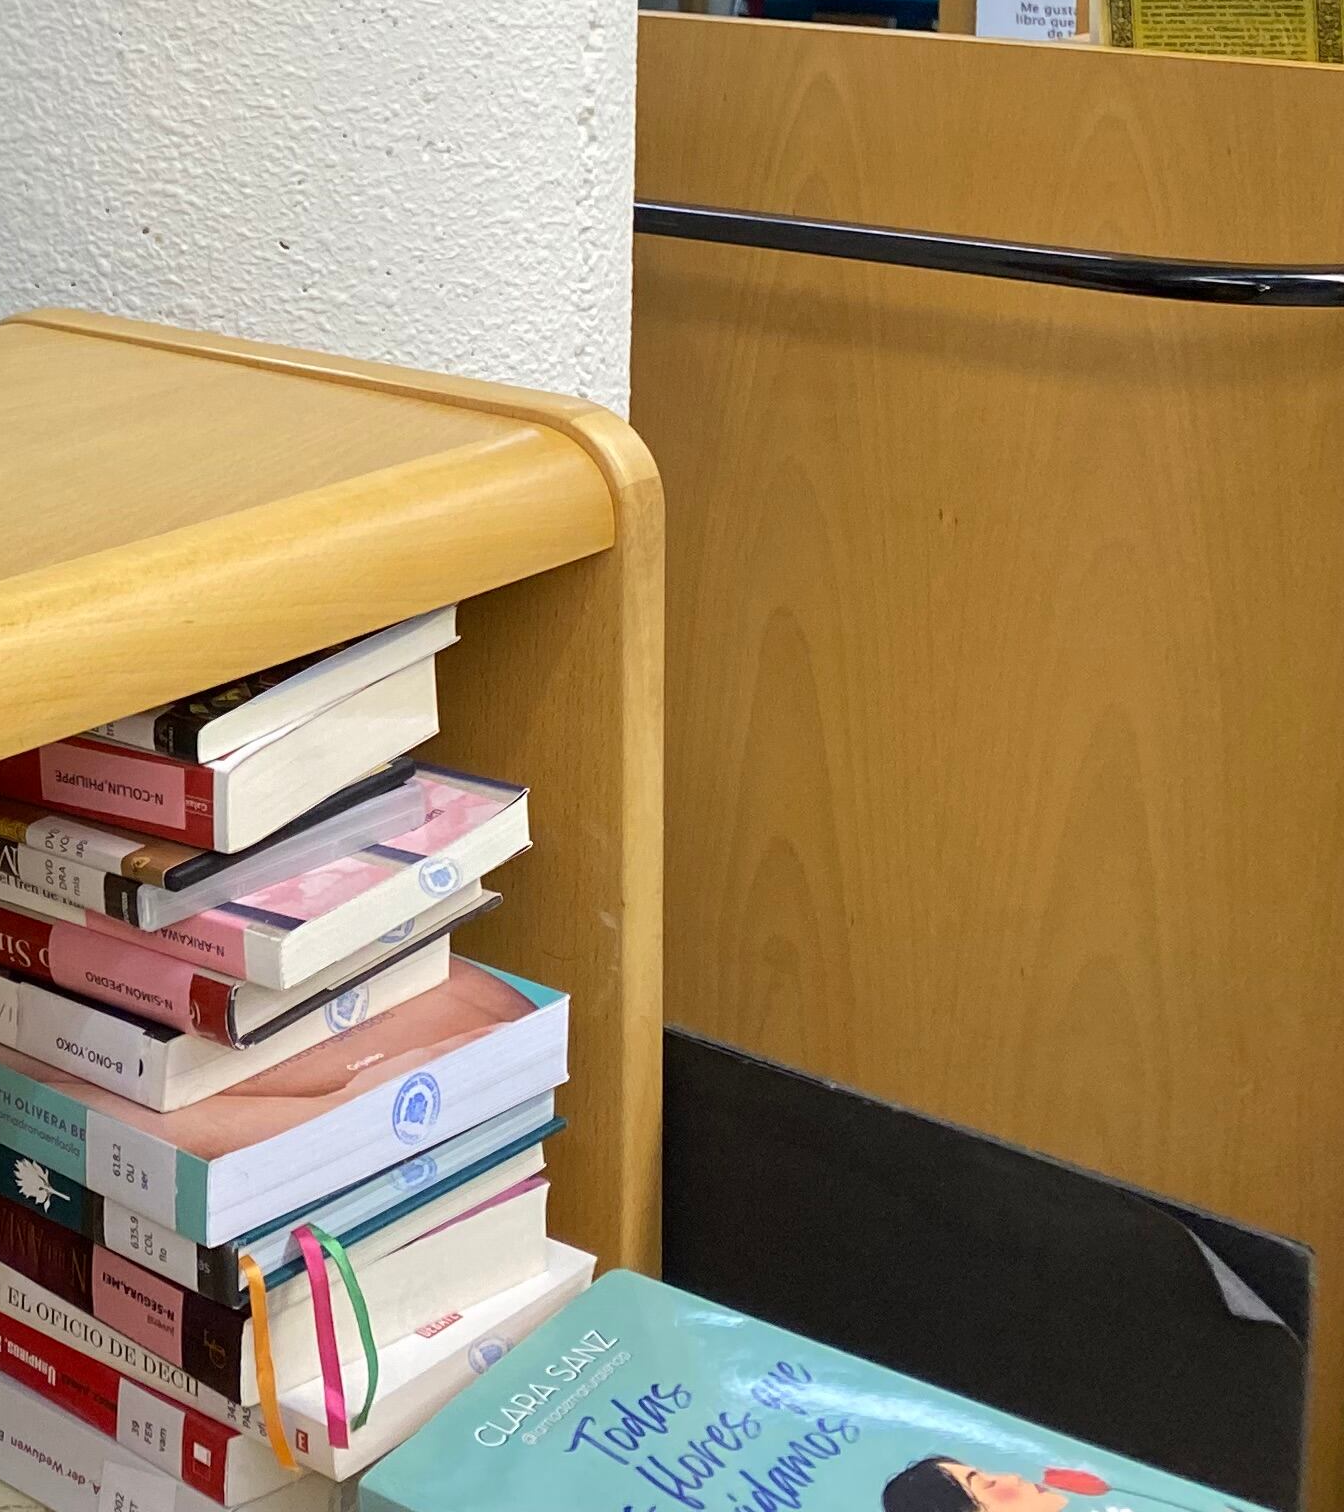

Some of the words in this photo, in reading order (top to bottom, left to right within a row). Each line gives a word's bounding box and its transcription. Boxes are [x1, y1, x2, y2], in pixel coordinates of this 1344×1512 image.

[1016, 14, 1048, 27] libro
[1021, 2, 1040, 14] Me
[55, 769, 164, 806] N-COLLIN,PHILIPPE
[85, 971, 174, 1011] N-SIMÓN,PEDRO
[55, 1037, 124, 1074] B-ONO,YOKO
[14, 1096, 68, 1130] OLIVERA
[112, 1143, 121, 1177] 618.2
[130, 1215, 139, 1250] 635.9
[144, 1232, 153, 1256] COL
[7, 1286, 33, 1314] EL
[36, 1302, 104, 1349] OFICIO
[108, 1337, 137, 1368] DE
[474, 1382, 560, 1448] CLARA
[545, 1328, 620, 1383] SANZ
[749, 1359, 813, 1416] que
[131, 1420, 140, 1437] 39
[144, 1421, 154, 1446] FER
[563, 1382, 693, 1466] Todas
[11, 1435, 63, 1476] Weduwen
